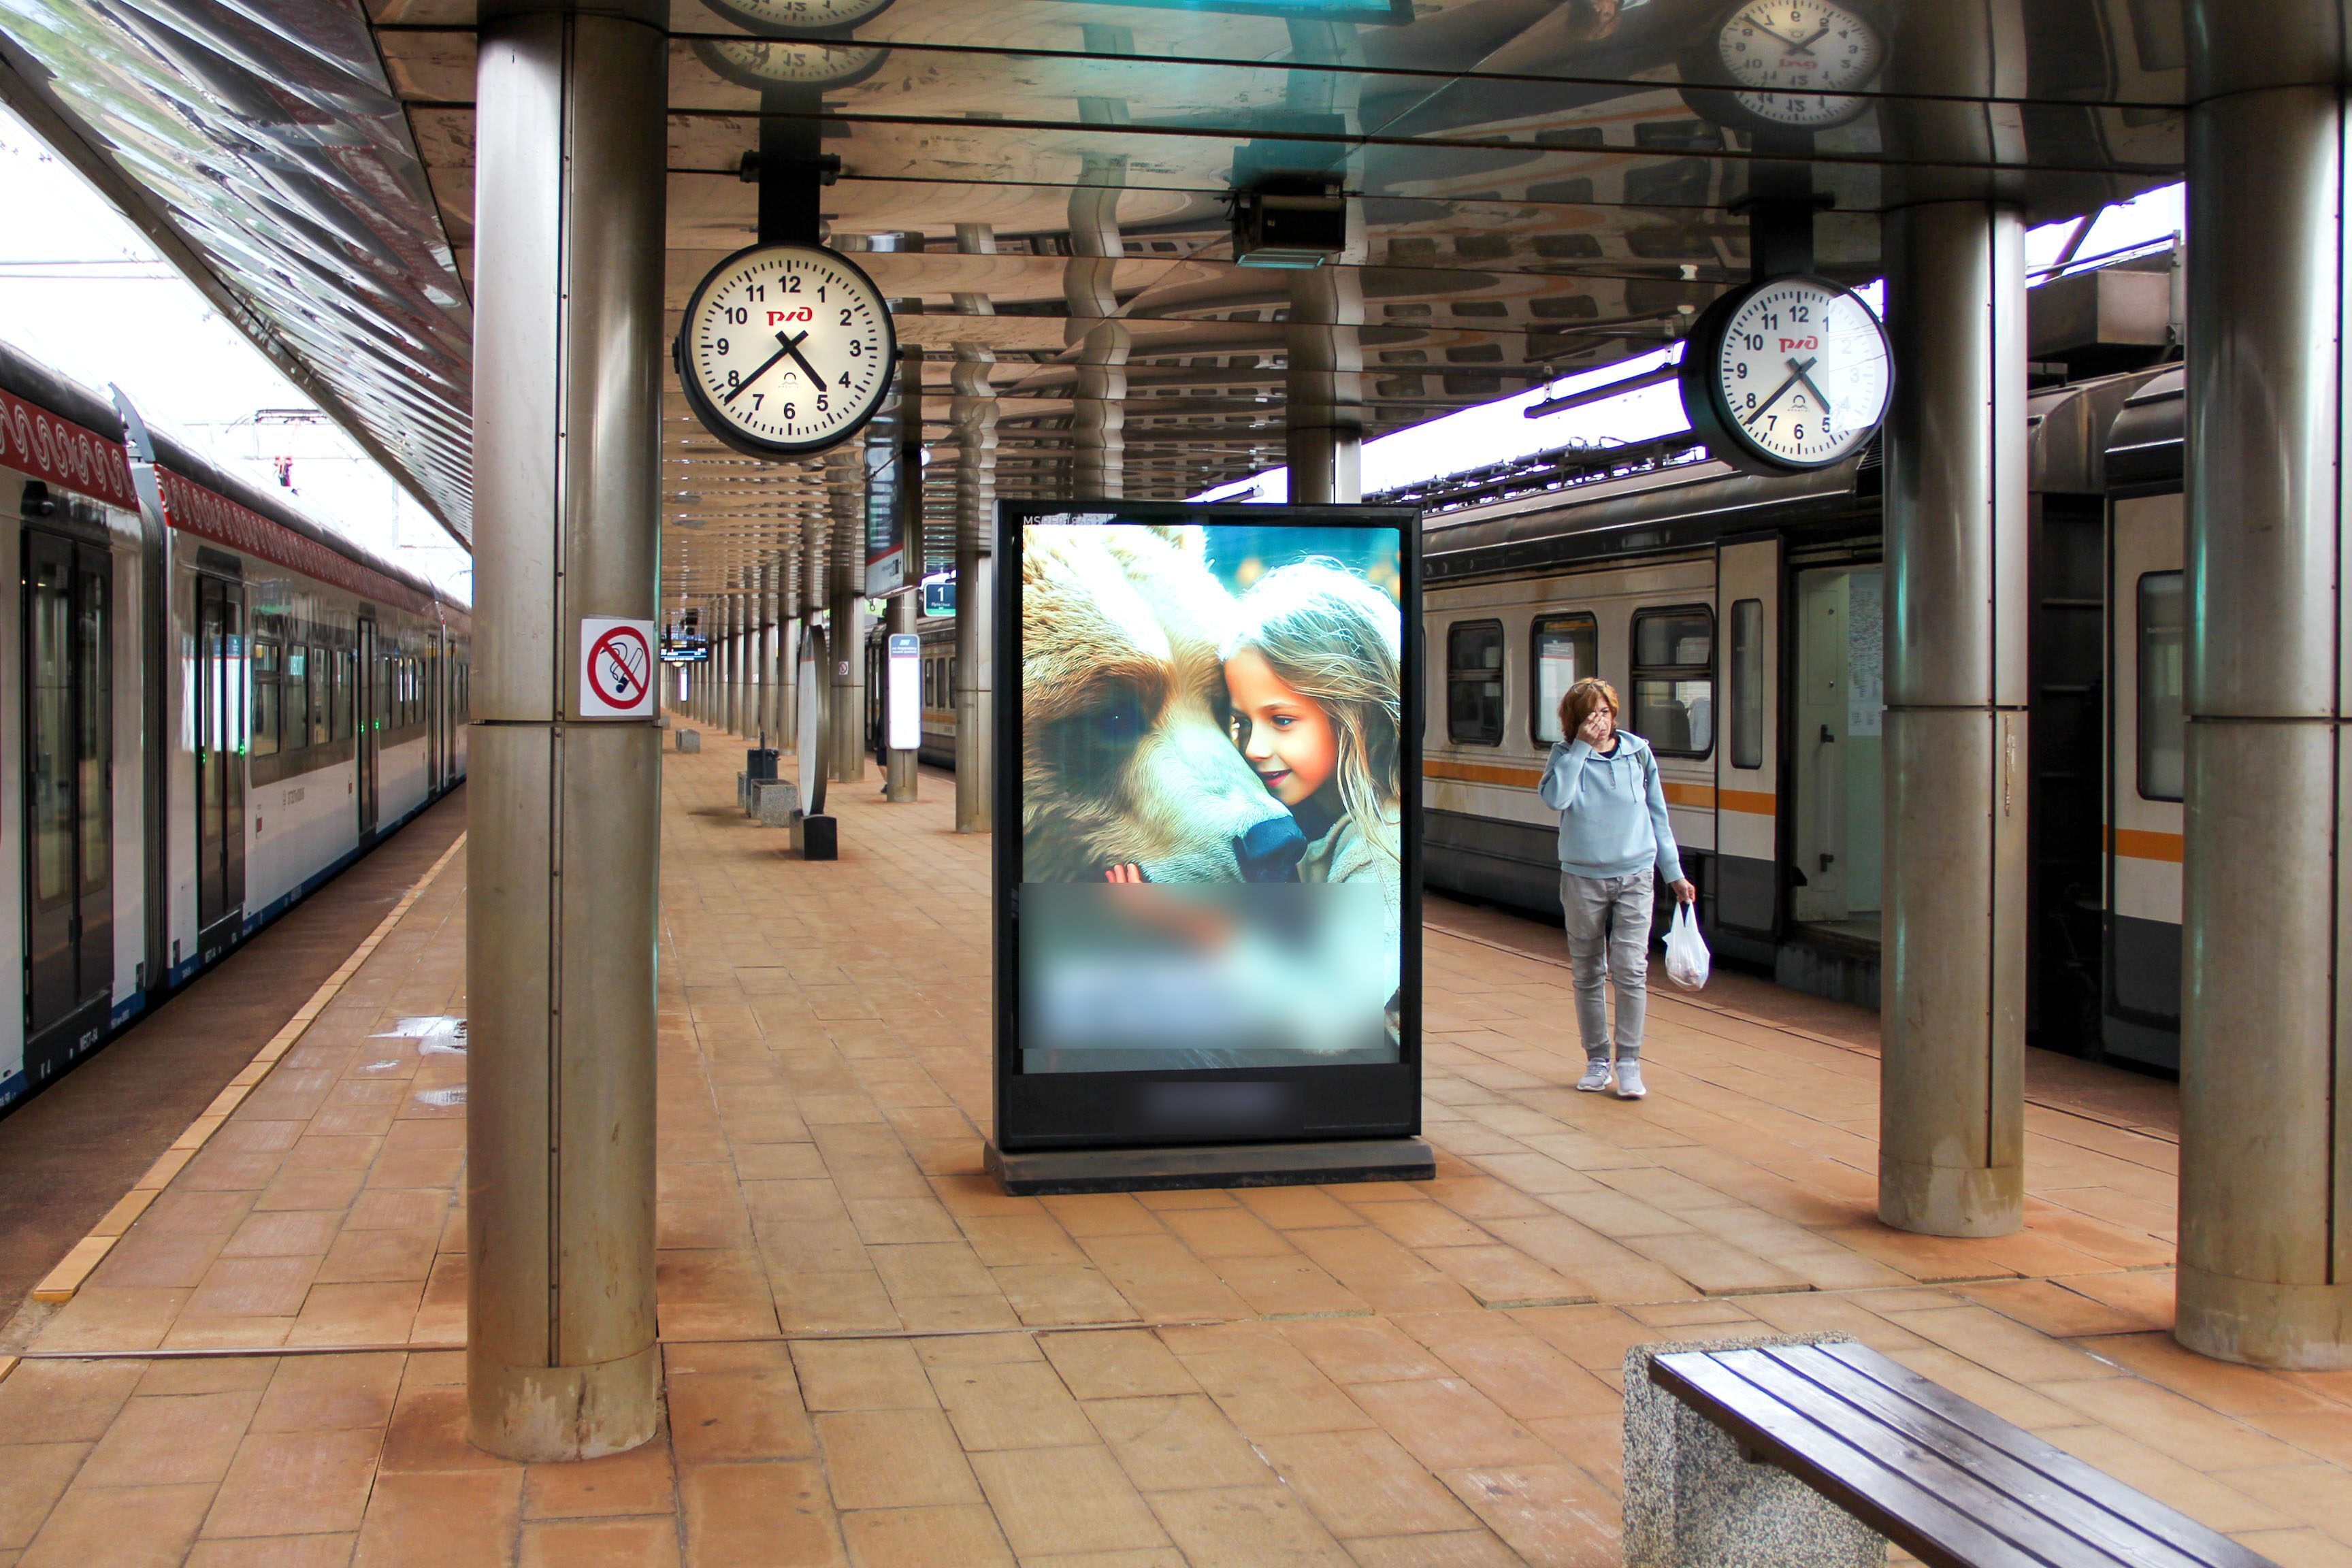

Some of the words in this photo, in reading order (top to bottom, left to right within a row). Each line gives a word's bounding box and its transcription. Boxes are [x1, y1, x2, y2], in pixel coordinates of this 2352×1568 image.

[746, 284, 764, 302] 11
[779, 276, 801, 293] 12
[817, 286, 825, 303] 1
[724, 307, 747, 324] 10
[840, 309, 852, 326] 2
[1761, 314, 1778, 330] 11
[1789, 306, 1809, 323] 12
[1822, 316, 1829, 332] 1
[717, 338, 729, 355] 9
[849, 340, 862, 357] 3
[1744, 334, 1763, 350] 10
[1842, 339, 1852, 355] 2
[728, 370, 740, 387] 8
[1737, 363, 1748, 379] 9
[1850, 367, 1860, 383] 3
[838, 371, 851, 389] 4
[753, 393, 764, 411] 7
[817, 394, 828, 411] 5
[1746, 393, 1757, 409] 8
[783, 402, 796, 419] 6
[1767, 415, 1778, 431] 7
[1821, 417, 1831, 433] 5
[1793, 424, 1803, 440] 6
[937, 587, 944, 602] 1
